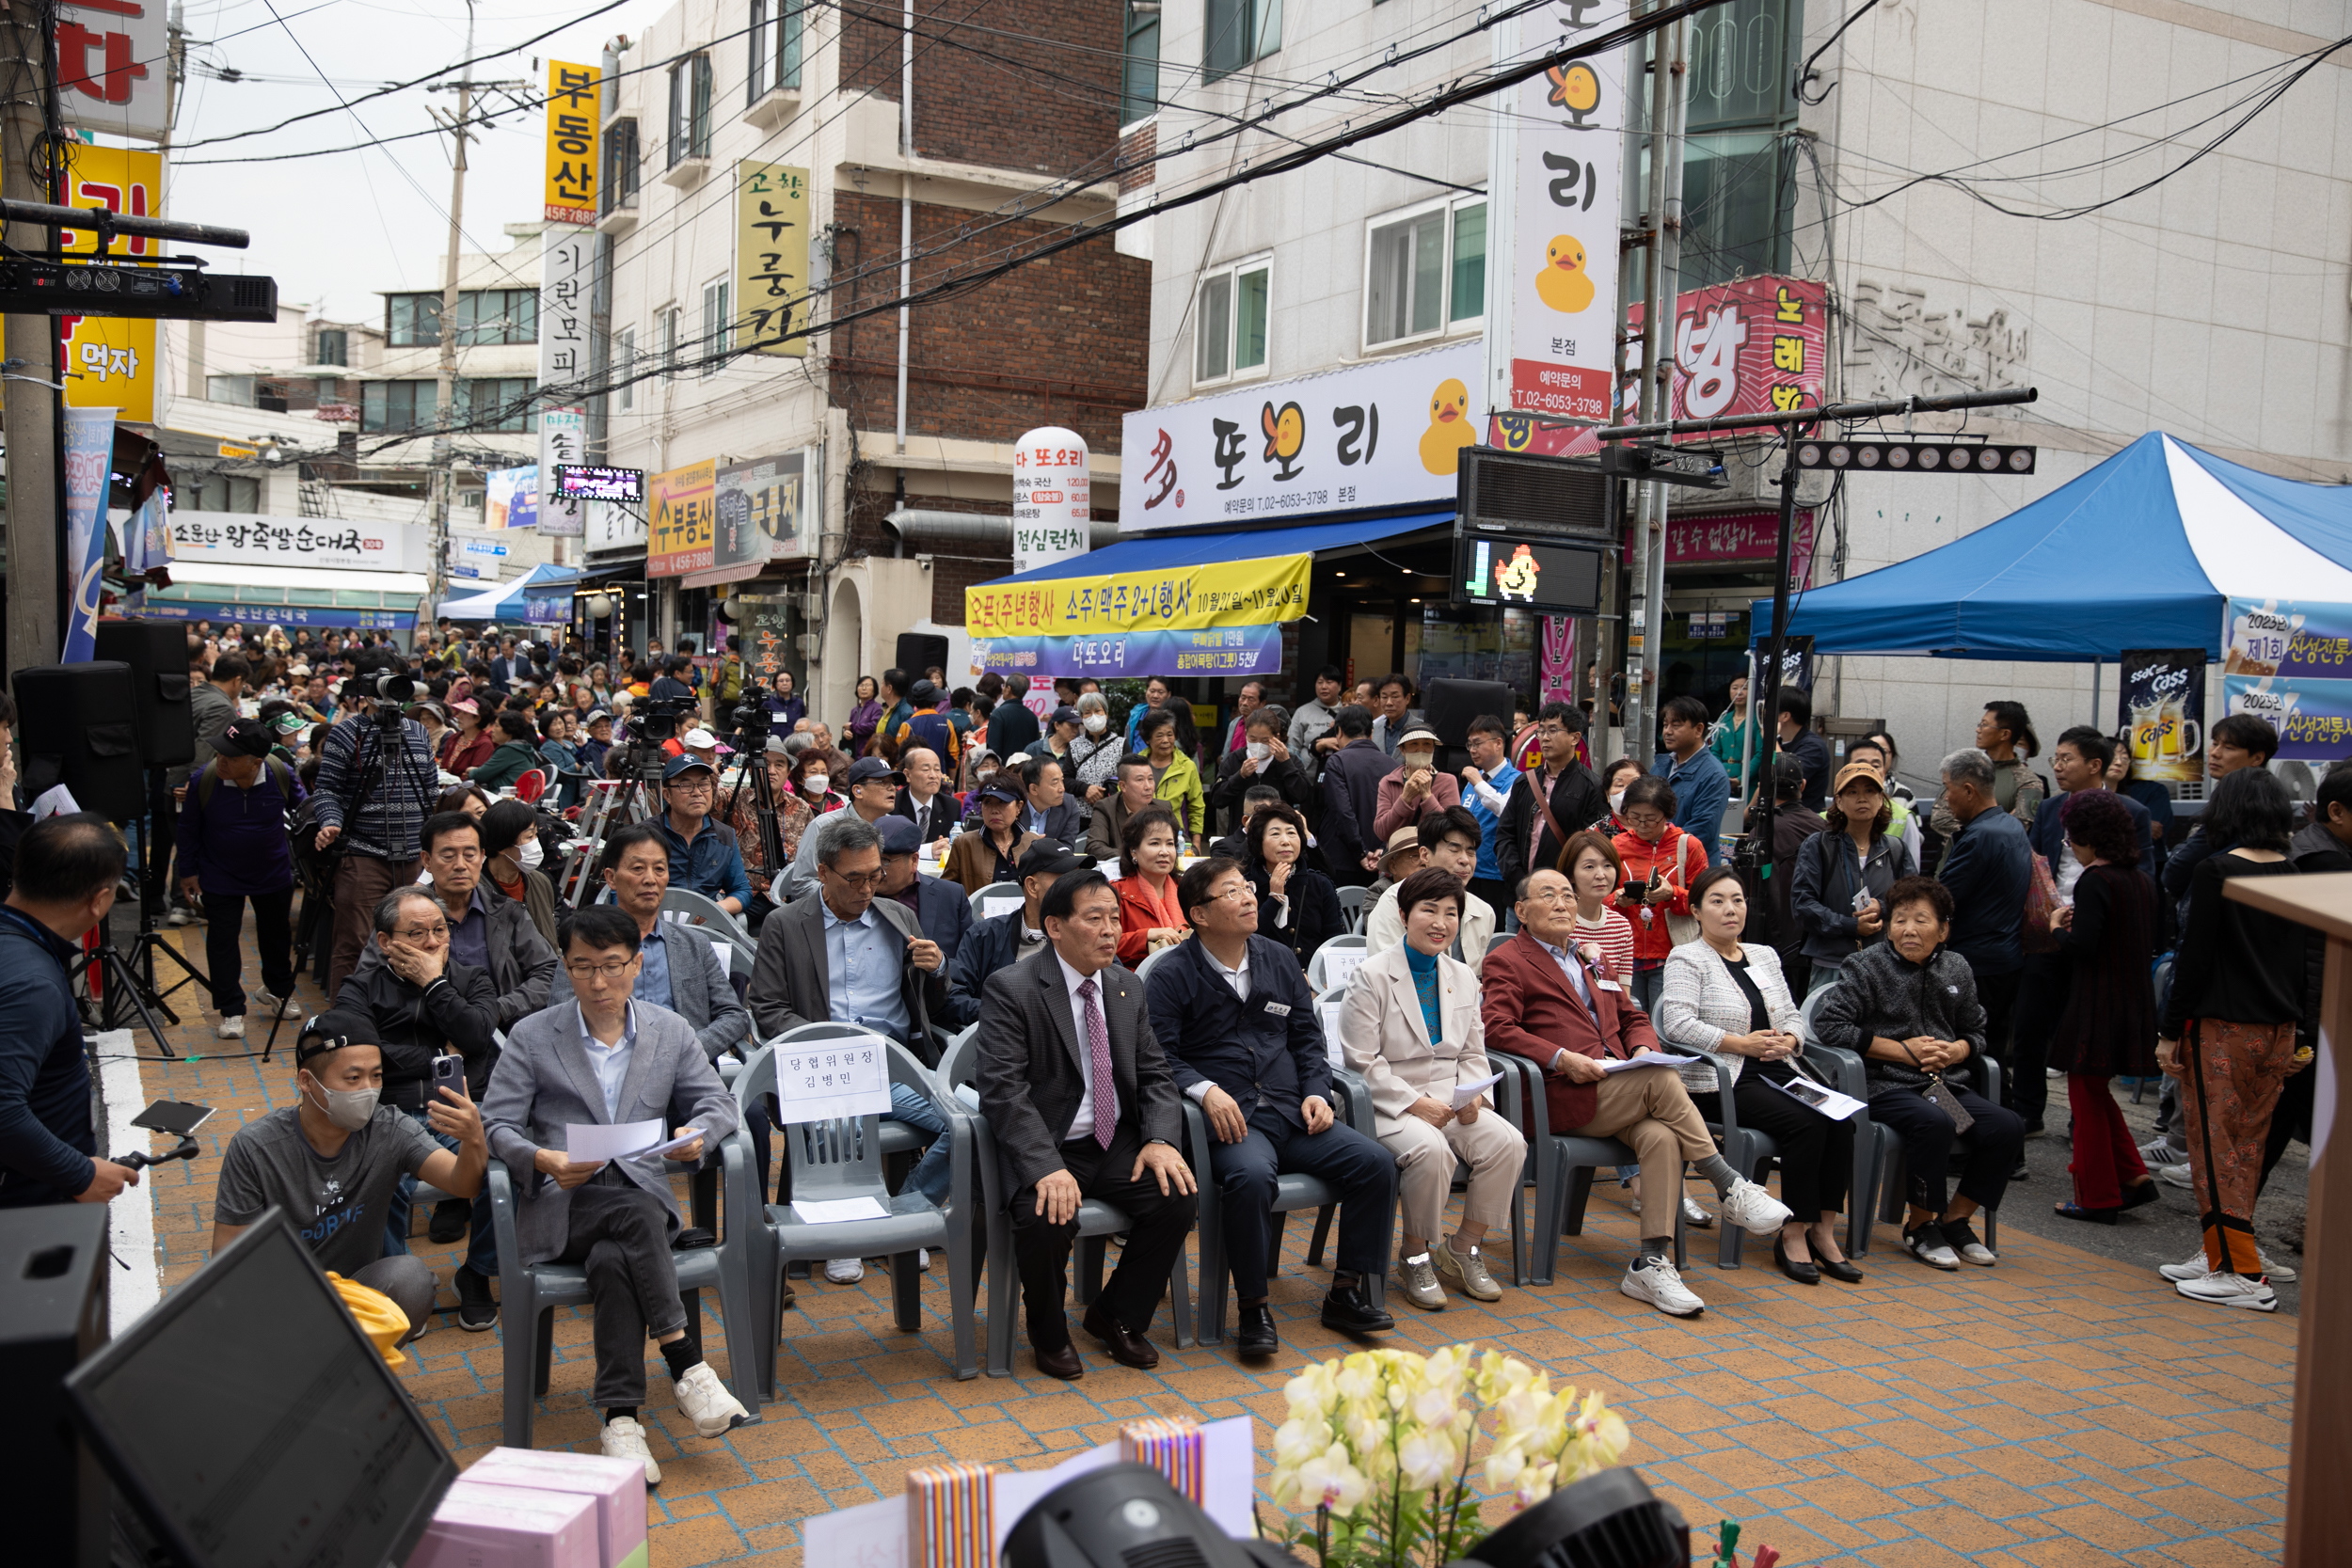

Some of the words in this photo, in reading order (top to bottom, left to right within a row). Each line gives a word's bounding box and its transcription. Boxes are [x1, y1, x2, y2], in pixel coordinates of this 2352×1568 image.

[552, 68, 594, 203] 부동산
[748, 200, 796, 338] 누룽지
[552, 244, 581, 380] 기린모피
[1550, 337, 1577, 356] 본점
[81, 343, 139, 382] 먹자
[1539, 370, 1581, 390] 예약문의
[1516, 388, 1603, 416] T.02-6053-3798
[547, 414, 581, 430] 마장
[1016, 451, 1027, 467] 다
[1035, 449, 1083, 467] 또오리
[1034, 477, 1052, 487] 국산
[751, 479, 798, 537] 누룽지
[1224, 497, 1254, 515] 예약문의
[1258, 490, 1328, 512] T.02-6053-3798
[1338, 484, 1357, 503] 본점
[175, 524, 222, 544] 소문난
[1017, 529, 1083, 552] 점심런치
[1671, 525, 1686, 557] 갈
[1690, 525, 1703, 553] 수
[675, 550, 712, 570] 456-7880
[1066, 585, 1128, 623] 소주/맥주
[1131, 578, 1192, 619] 2+1행사
[2248, 614, 2288, 631] 2023년
[1073, 638, 1126, 669] 다또오리
[2248, 636, 2283, 662] 제1회
[2288, 636, 2352, 666] 신성전통
[2243, 694, 2284, 711] 2023년
[1462, 793, 1475, 809] 김
